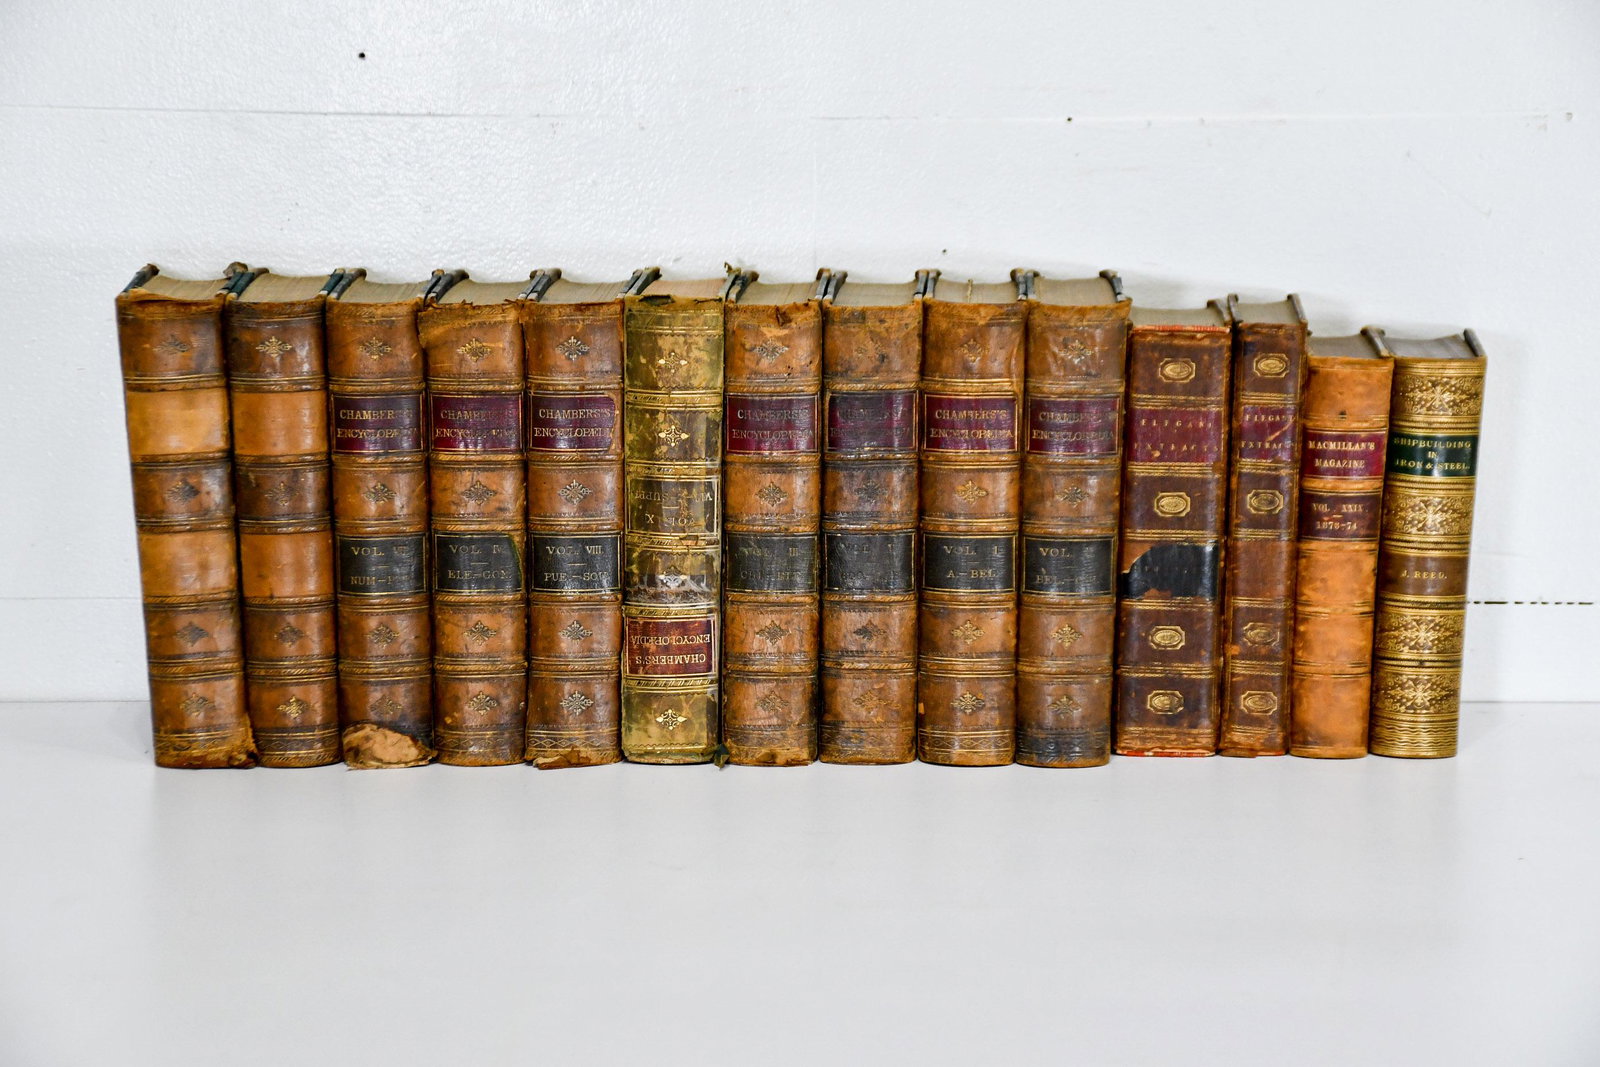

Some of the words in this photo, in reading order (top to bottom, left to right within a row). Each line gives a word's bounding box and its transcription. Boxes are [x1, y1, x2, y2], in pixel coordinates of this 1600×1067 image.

[538, 408, 611, 420] CHAMBERS'S
[1308, 440, 1376, 450] MACMILLAN'S
[1394, 438, 1471, 449] SHIPBUILDING
[1427, 451, 1438, 459] IN
[1314, 459, 1366, 468] MAGAZINE
[1396, 458, 1423, 469] IRON
[351, 546, 385, 556] VOL.
[449, 544, 482, 554] VOL.
[1401, 569, 1410, 578] J.
[635, 653, 706, 665] CHAMBERS'S
